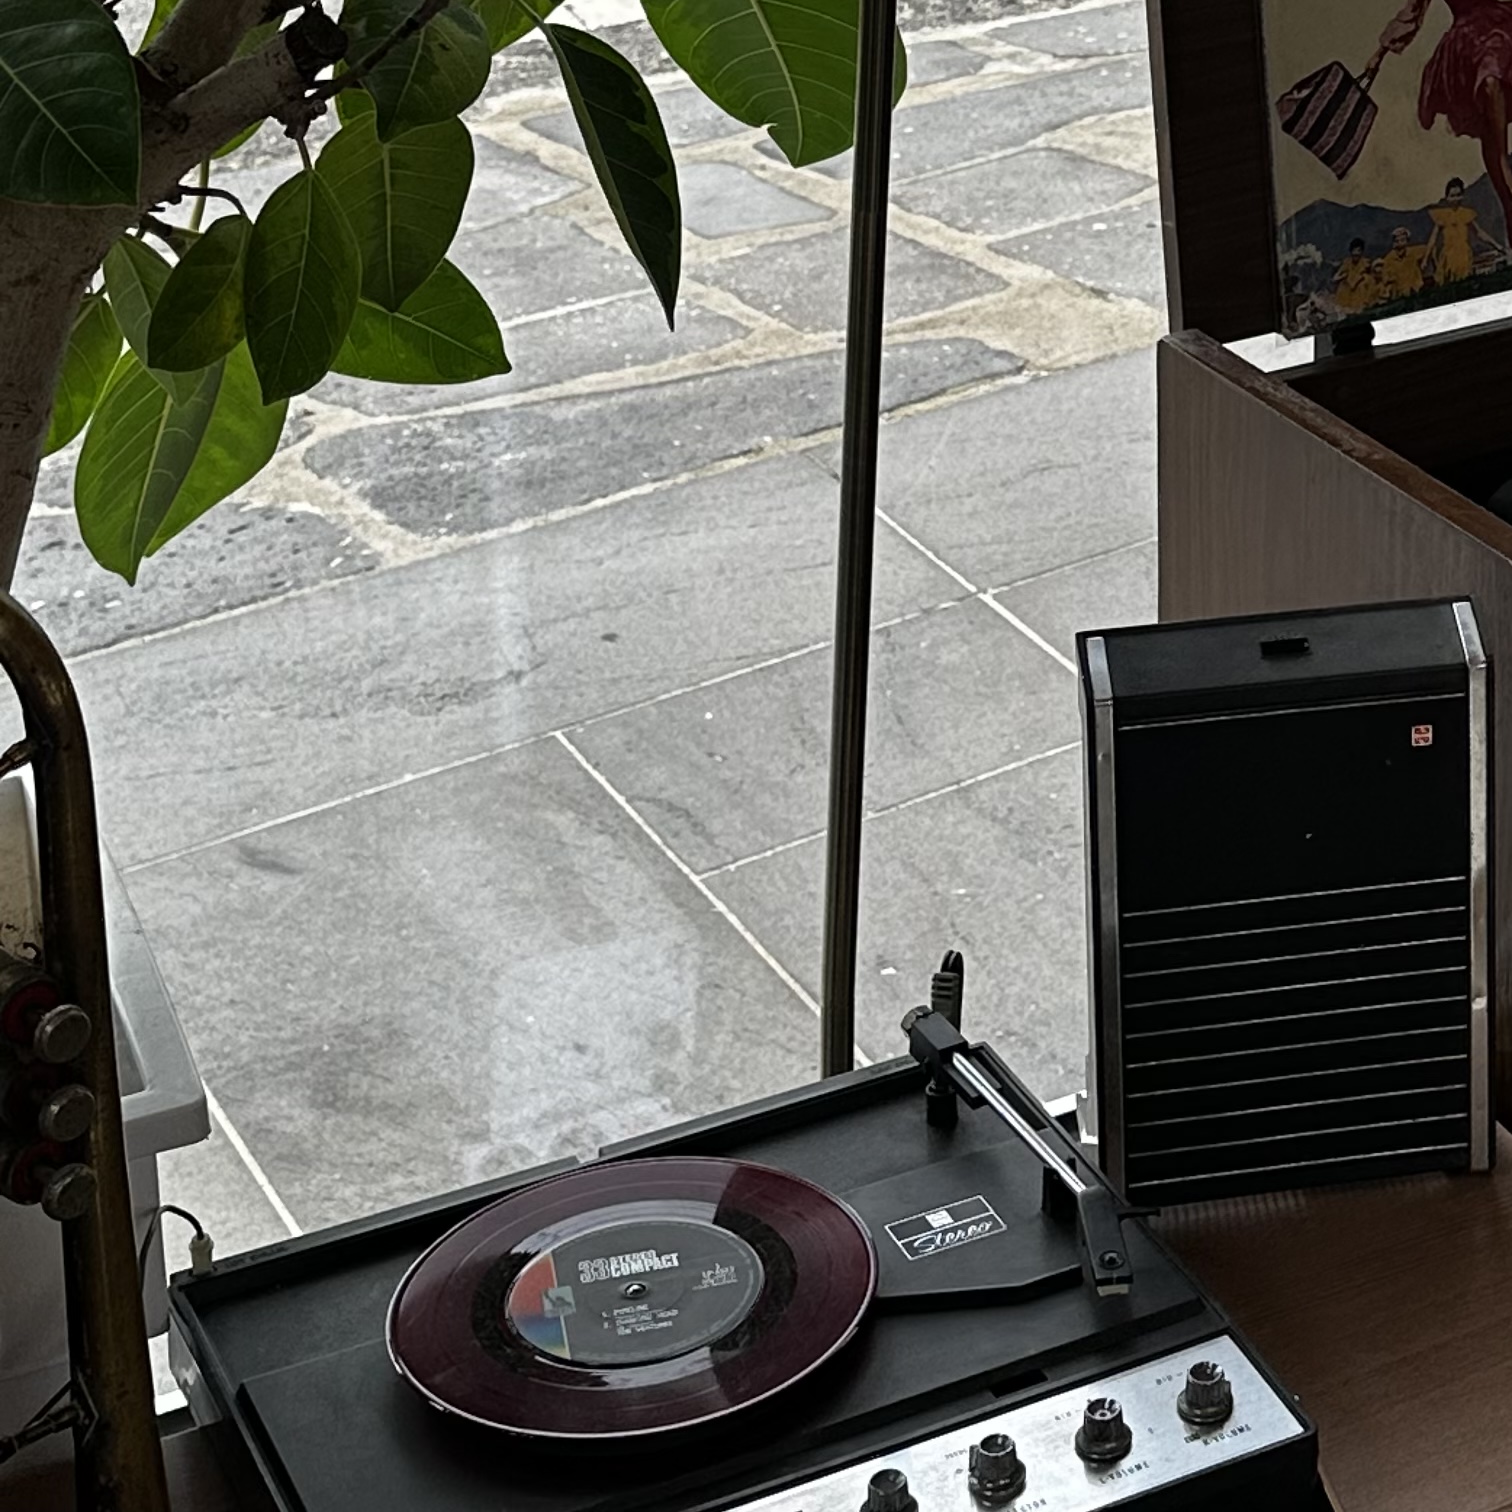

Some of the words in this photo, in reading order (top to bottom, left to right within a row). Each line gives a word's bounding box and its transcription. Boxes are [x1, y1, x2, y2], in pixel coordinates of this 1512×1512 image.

[912, 1220, 994, 1254] Stereo
[578, 1257, 610, 1284] 33
[610, 1252, 680, 1278] COMPACT
